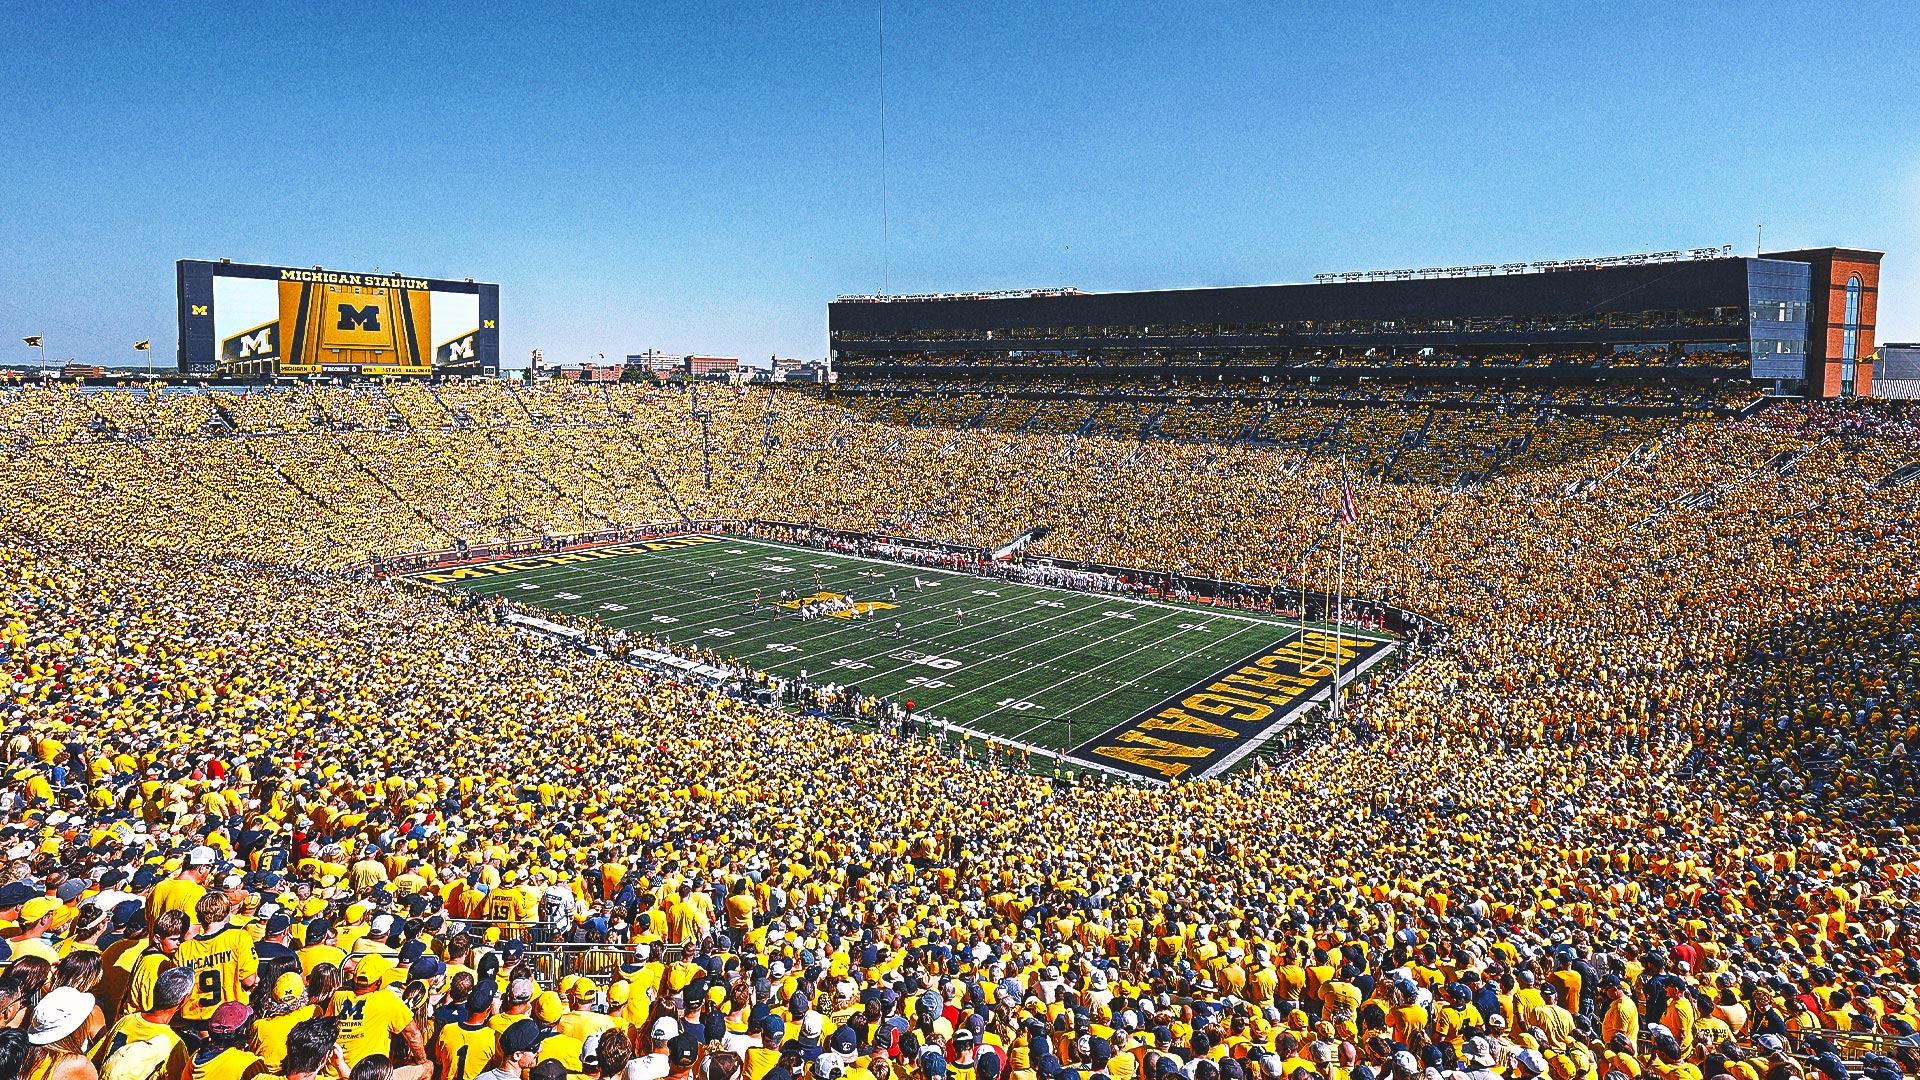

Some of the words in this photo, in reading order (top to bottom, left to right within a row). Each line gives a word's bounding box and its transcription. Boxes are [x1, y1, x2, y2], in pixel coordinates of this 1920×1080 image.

[280, 269, 361, 285] MICHIGAN
[365, 276, 429, 290] STADIUM
[191, 305, 208, 316] M
[337, 303, 381, 331] M
[484, 320, 495, 328] M
[240, 328, 273, 358] M
[449, 336, 475, 361] M
[414, 535, 721, 584] MICHIGAN
[493, 905, 509, 920] 19
[199, 970, 221, 1007] 9
[340, 999, 367, 1020] M
[456, 1044, 469, 1080] 1
